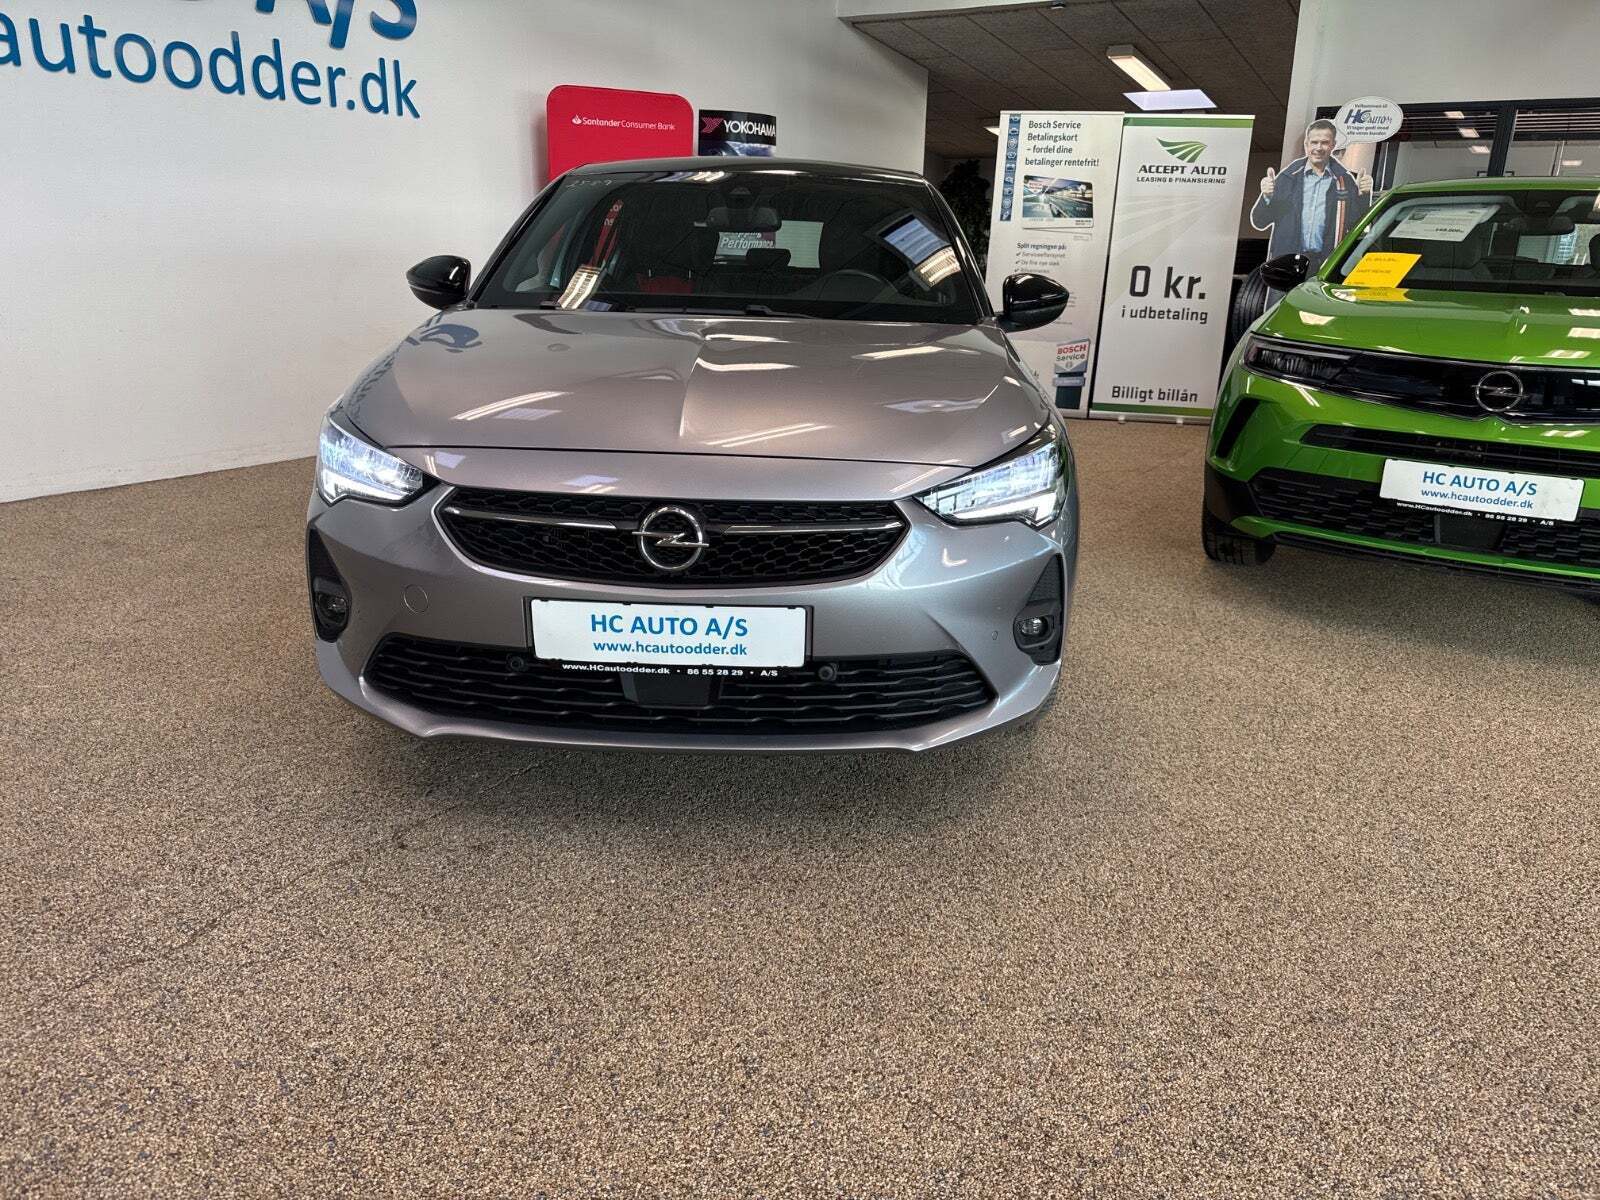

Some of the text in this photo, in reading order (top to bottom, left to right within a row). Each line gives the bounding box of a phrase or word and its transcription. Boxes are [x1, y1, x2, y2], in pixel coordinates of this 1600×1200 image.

[582, 117, 675, 130] Santander Consumer Bank
[724, 119, 776, 137] YOKOHAMA
[1029, 120, 1081, 129] Bosch Service
[1027, 133, 1078, 143] Betalingskort
[1032, 145, 1055, 153] fordel
[1056, 145, 1073, 154] dine
[1025, 157, 1099, 167] betalinger rentefrit!
[1138, 165, 1227, 175] ACCEPT AUTO
[1129, 265, 1206, 299] 0 kr.
[1121, 305, 1208, 325] i udbetaling
[1057, 344, 1087, 354] BOSCH
[1111, 385, 1198, 402] Billigt billån
[1422, 470, 1537, 497] HC AUTO A/S
[1421, 488, 1533, 509] www.hcautoodder.dk
[591, 614, 748, 640] HC AUTO A/S
[593, 640, 747, 656] www.hcautoodder.dk
[562, 664, 670, 675] www.HCautoodder.dk
